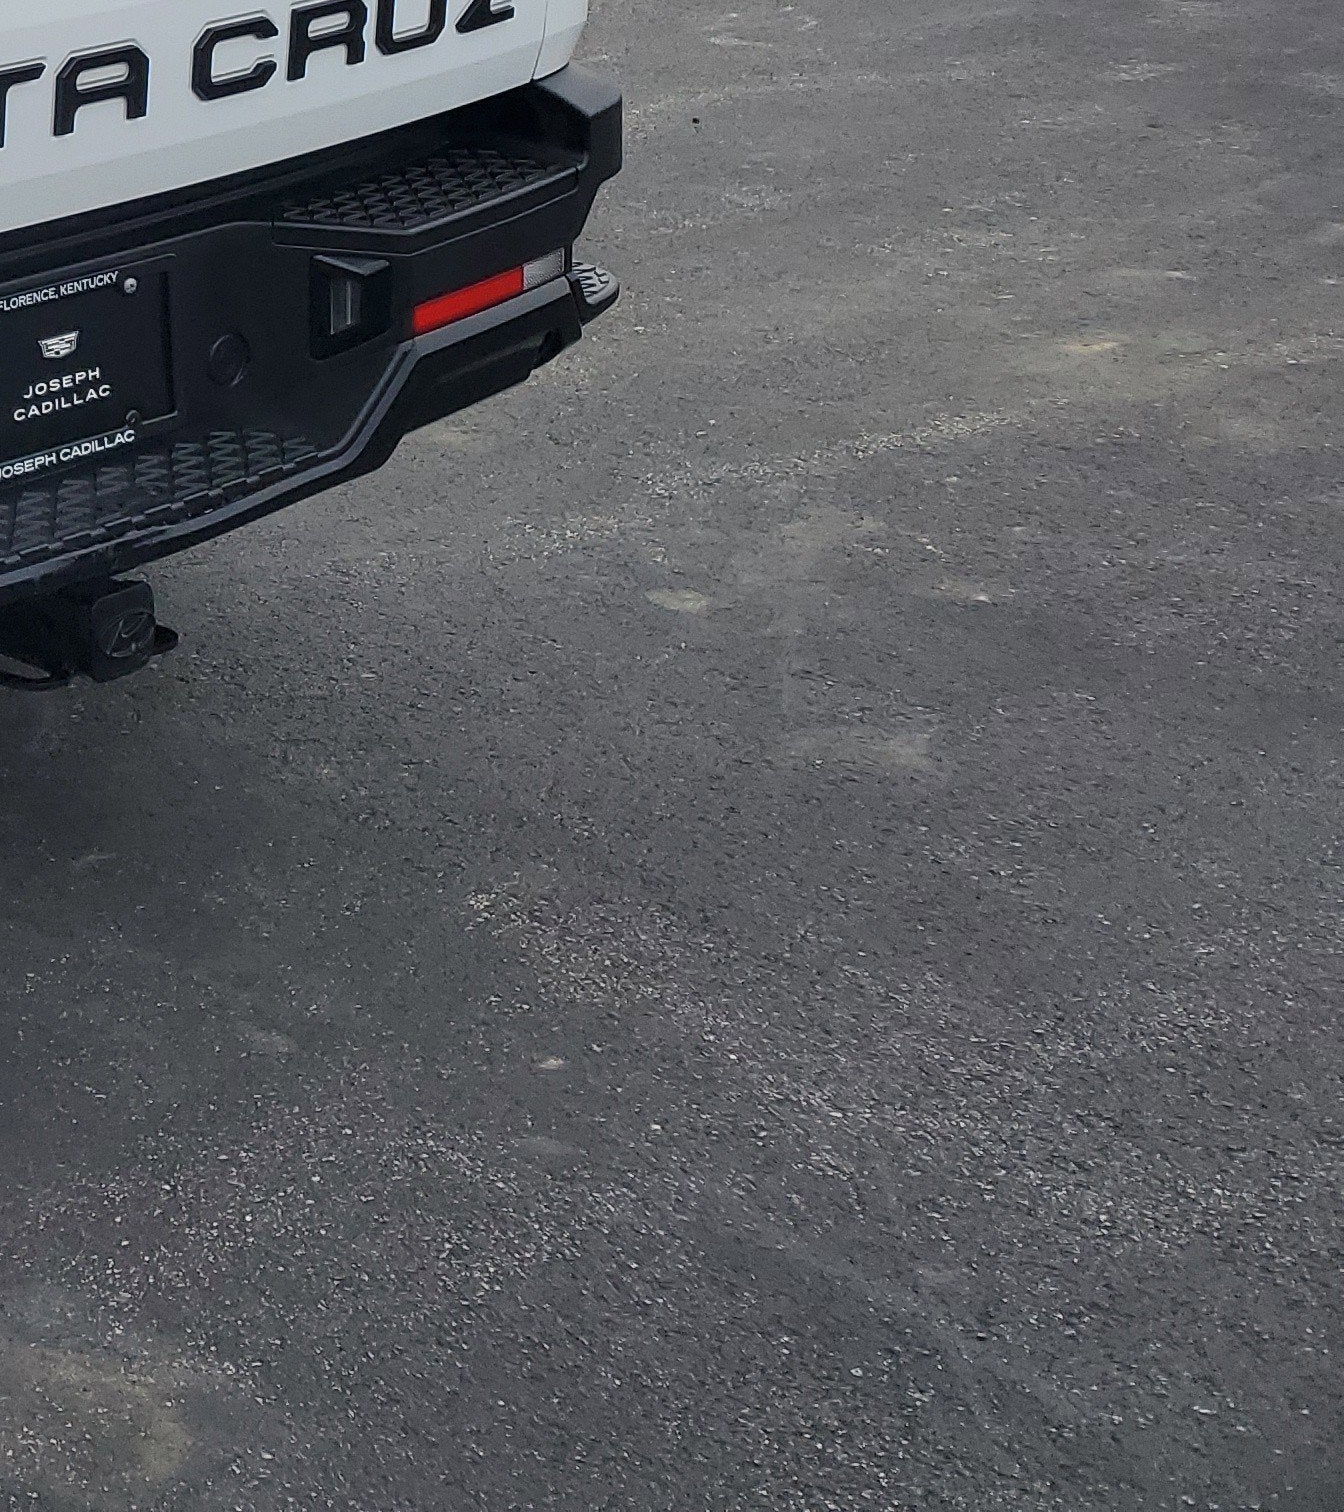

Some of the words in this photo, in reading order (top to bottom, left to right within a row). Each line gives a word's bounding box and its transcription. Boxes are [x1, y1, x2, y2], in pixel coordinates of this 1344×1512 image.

[59, 270, 119, 297] KENTUCKY
[23, 366, 101, 399] JOSEPH
[13, 384, 111, 422] CADILLAC
[59, 429, 136, 462] CADILLAC
